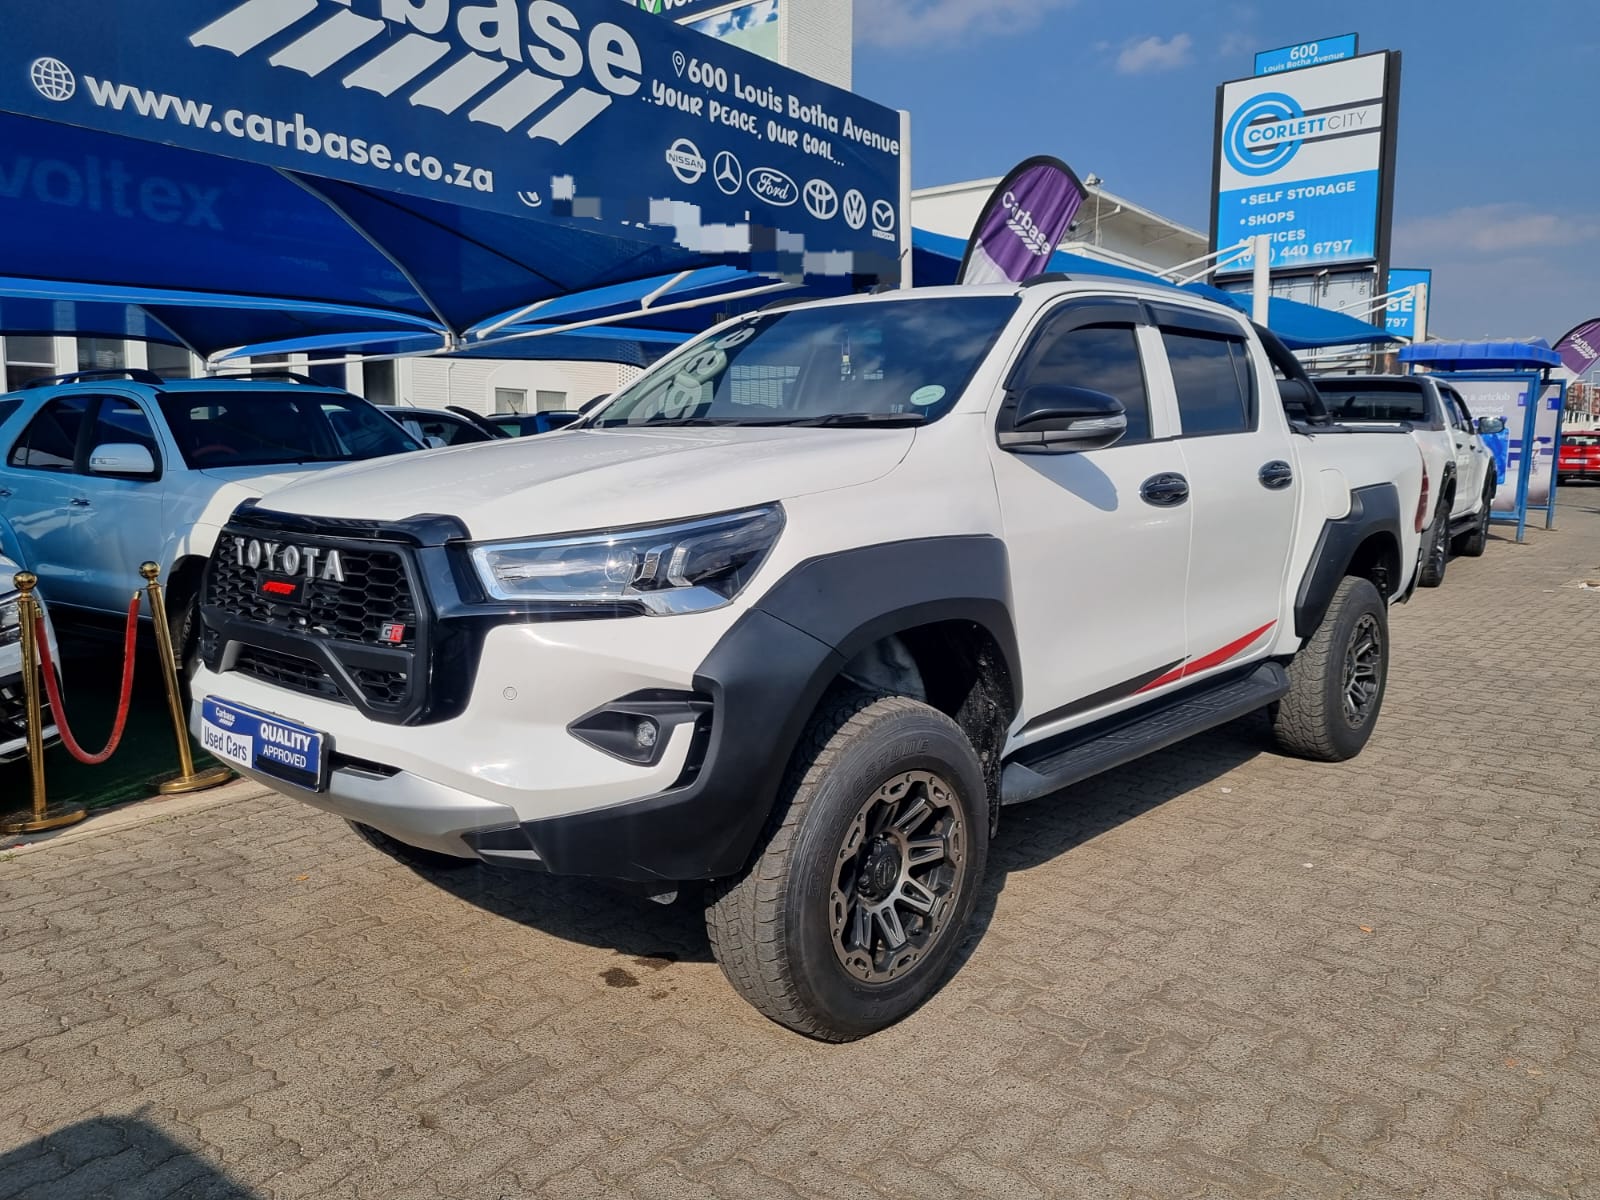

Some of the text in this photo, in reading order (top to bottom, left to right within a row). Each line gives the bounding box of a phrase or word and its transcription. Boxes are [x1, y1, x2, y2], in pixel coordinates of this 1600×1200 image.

[1263, 52, 1345, 73] Louis Botha Avenue
[1290, 43, 1318, 60] 600
[688, 59, 899, 155] 600 Louis Botha Avenue
[85, 75, 494, 193] www.carbase.co.za
[767, 121, 798, 147] OUR
[668, 152, 704, 169] NISSAN
[756, 172, 790, 200] Ford
[1249, 181, 1356, 205] SELF STORAGE
[1248, 211, 1295, 226] SHOPS
[1280, 244, 1308, 257] 440
[1313, 240, 1353, 255] 6797
[1385, 318, 1408, 328] 797
[234, 538, 345, 582] TOYOTA
[382, 624, 405, 642] GR
[215, 707, 236, 721] Carbase
[204, 725, 248, 761] Used Cars
[260, 722, 311, 752] QUALITY
[262, 744, 307, 768] APPROVED
